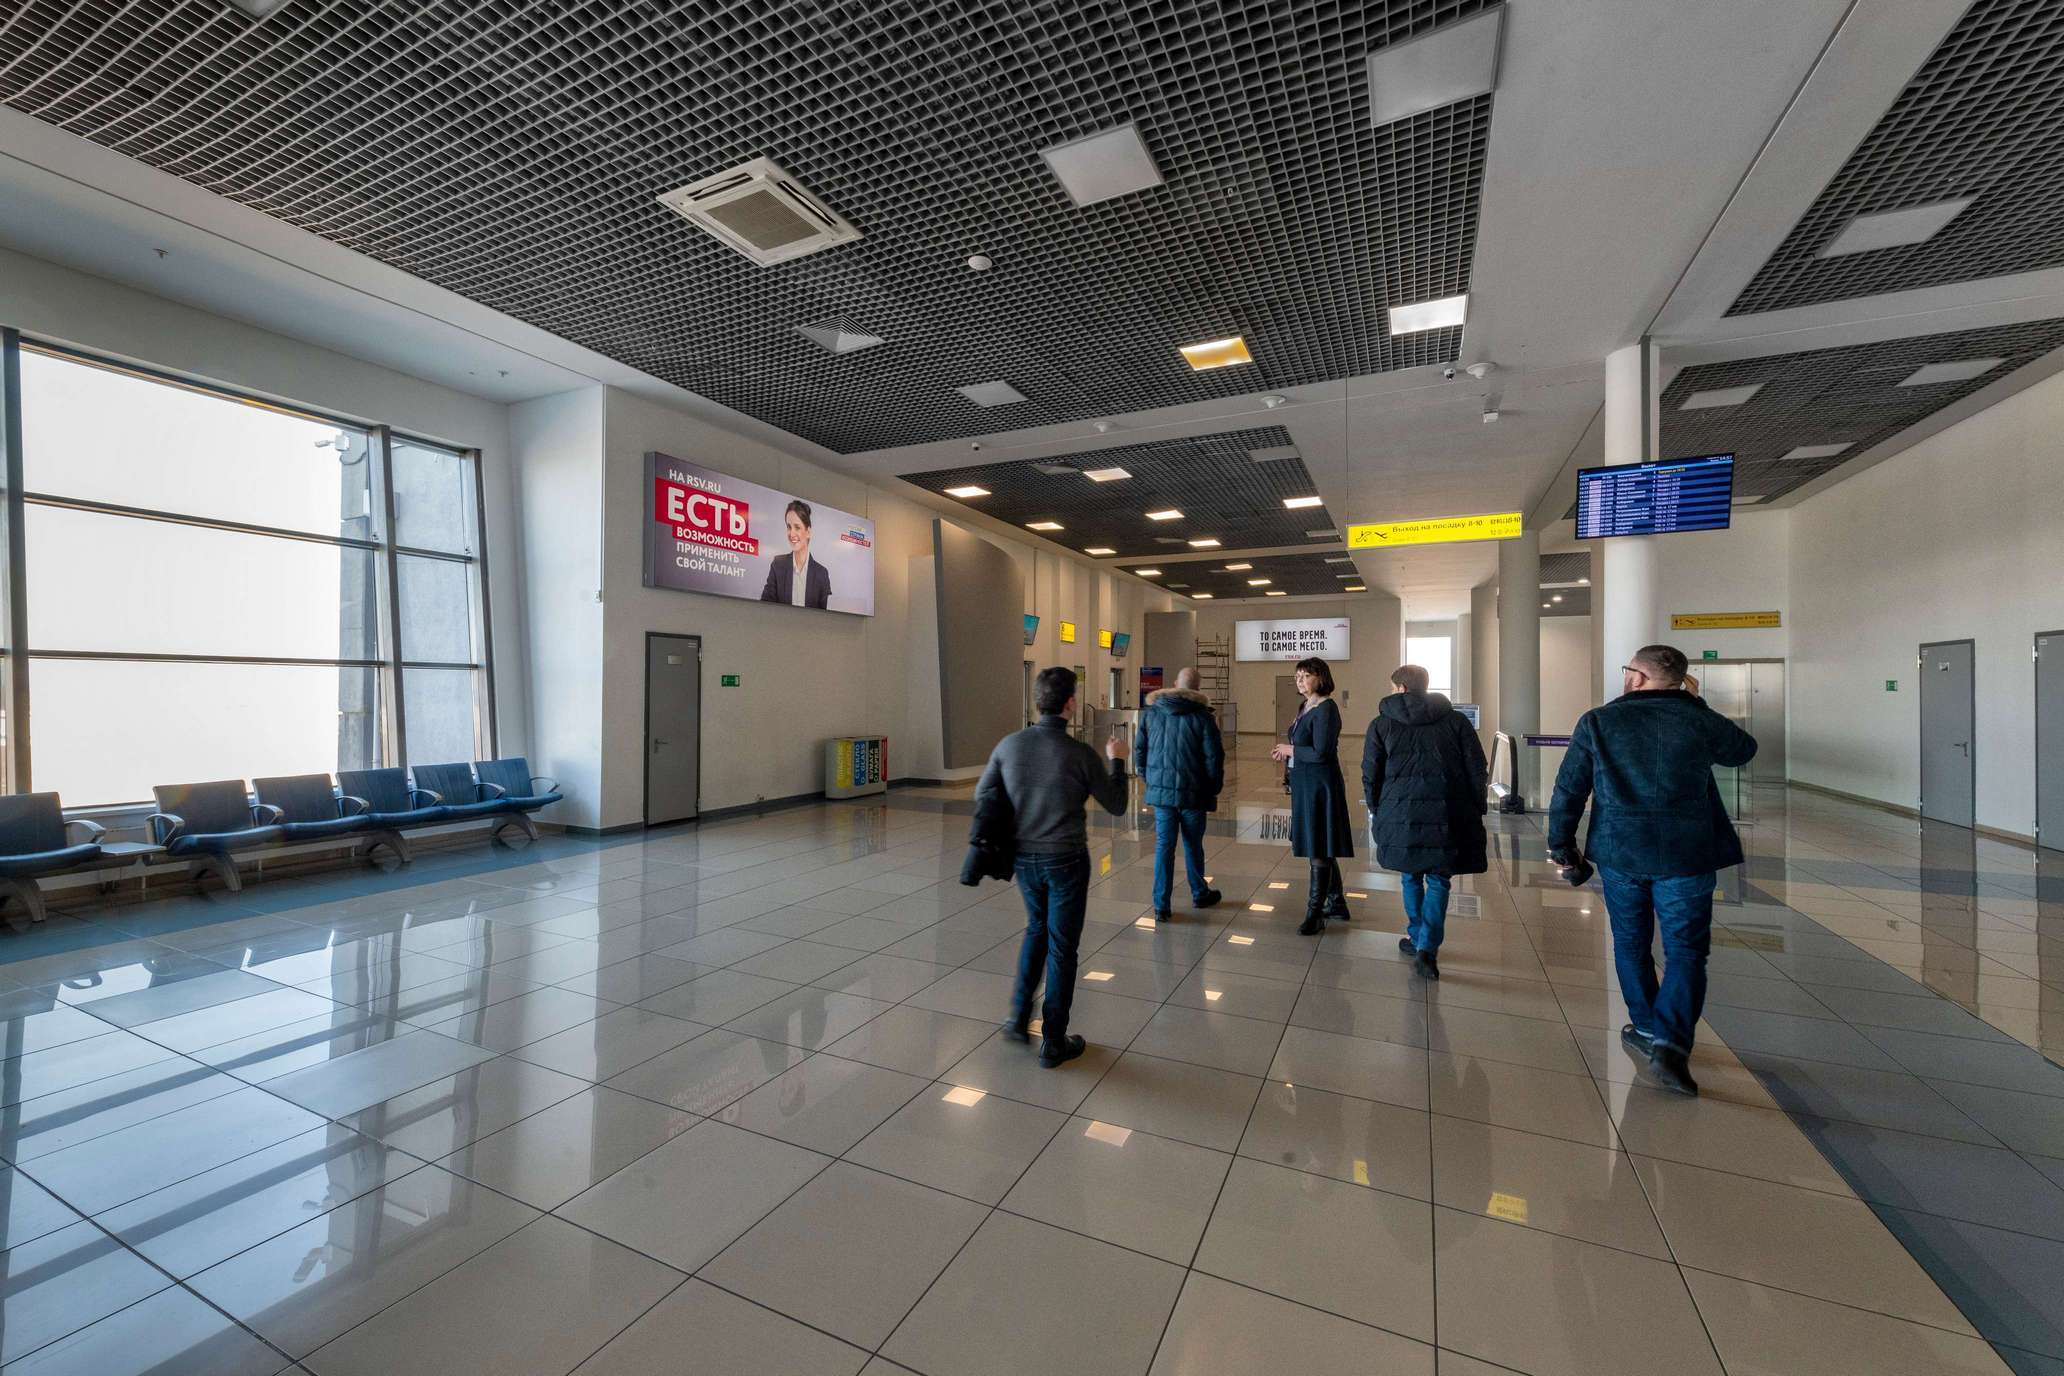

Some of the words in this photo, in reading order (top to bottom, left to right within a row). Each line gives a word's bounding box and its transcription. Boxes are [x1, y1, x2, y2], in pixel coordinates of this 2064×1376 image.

[669, 469, 685, 482] НА
[687, 474, 720, 493] RSV.RU
[668, 486, 746, 536] ЕСТЬ
[676, 526, 755, 553] ВОЗМОЖНОСТЬ
[676, 541, 740, 563] ПРИМЕНИТЬ
[676, 556, 706, 572] СВОЙ
[707, 562, 746, 577] ТАЛАНТ
[1260, 631, 1270, 641] ТО
[1271, 631, 1297, 641] САМОЕ
[1299, 630, 1328, 640] ВРЕМЯ.
[1260, 642, 1270, 652] ТО
[1271, 642, 1297, 652] САМОЕ
[1299, 641, 1328, 651] МЕСТО.
